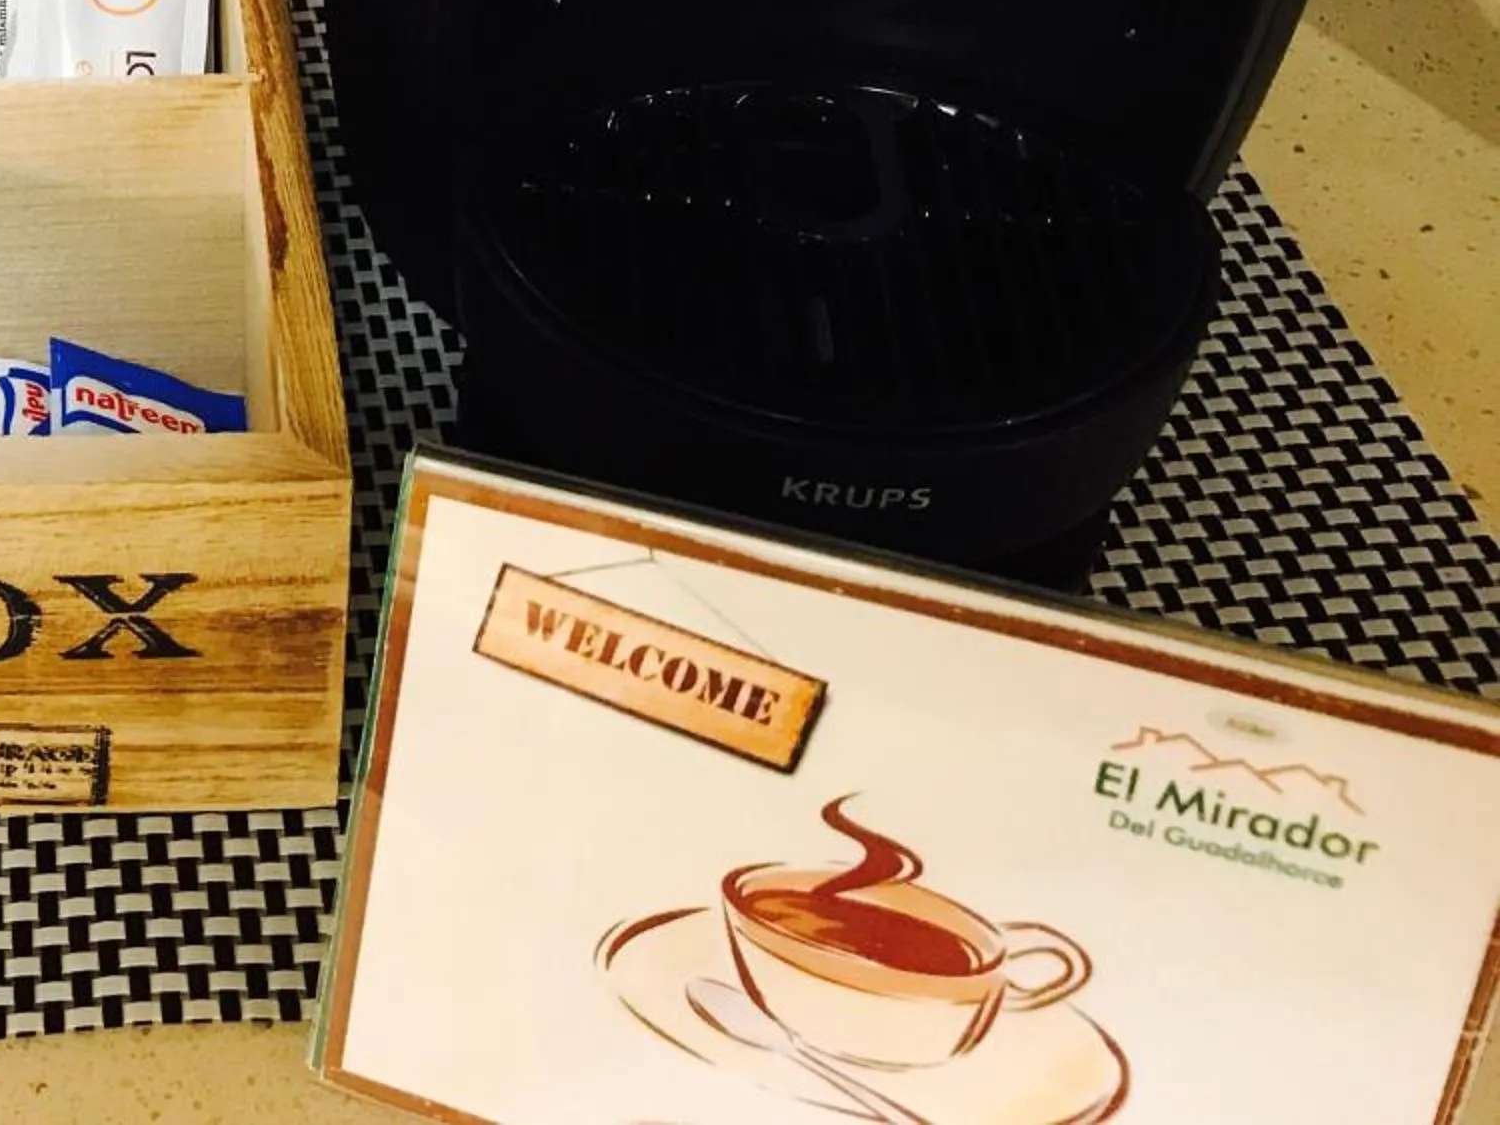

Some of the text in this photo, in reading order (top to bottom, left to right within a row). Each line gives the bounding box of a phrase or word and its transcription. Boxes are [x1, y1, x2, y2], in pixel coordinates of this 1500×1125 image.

[75, 385, 201, 433] natreen
[780, 476, 932, 510] KRUPS
[526, 600, 781, 726] WELCOME
[1094, 760, 1381, 865] El Mirador
[1108, 810, 1157, 839] Del
